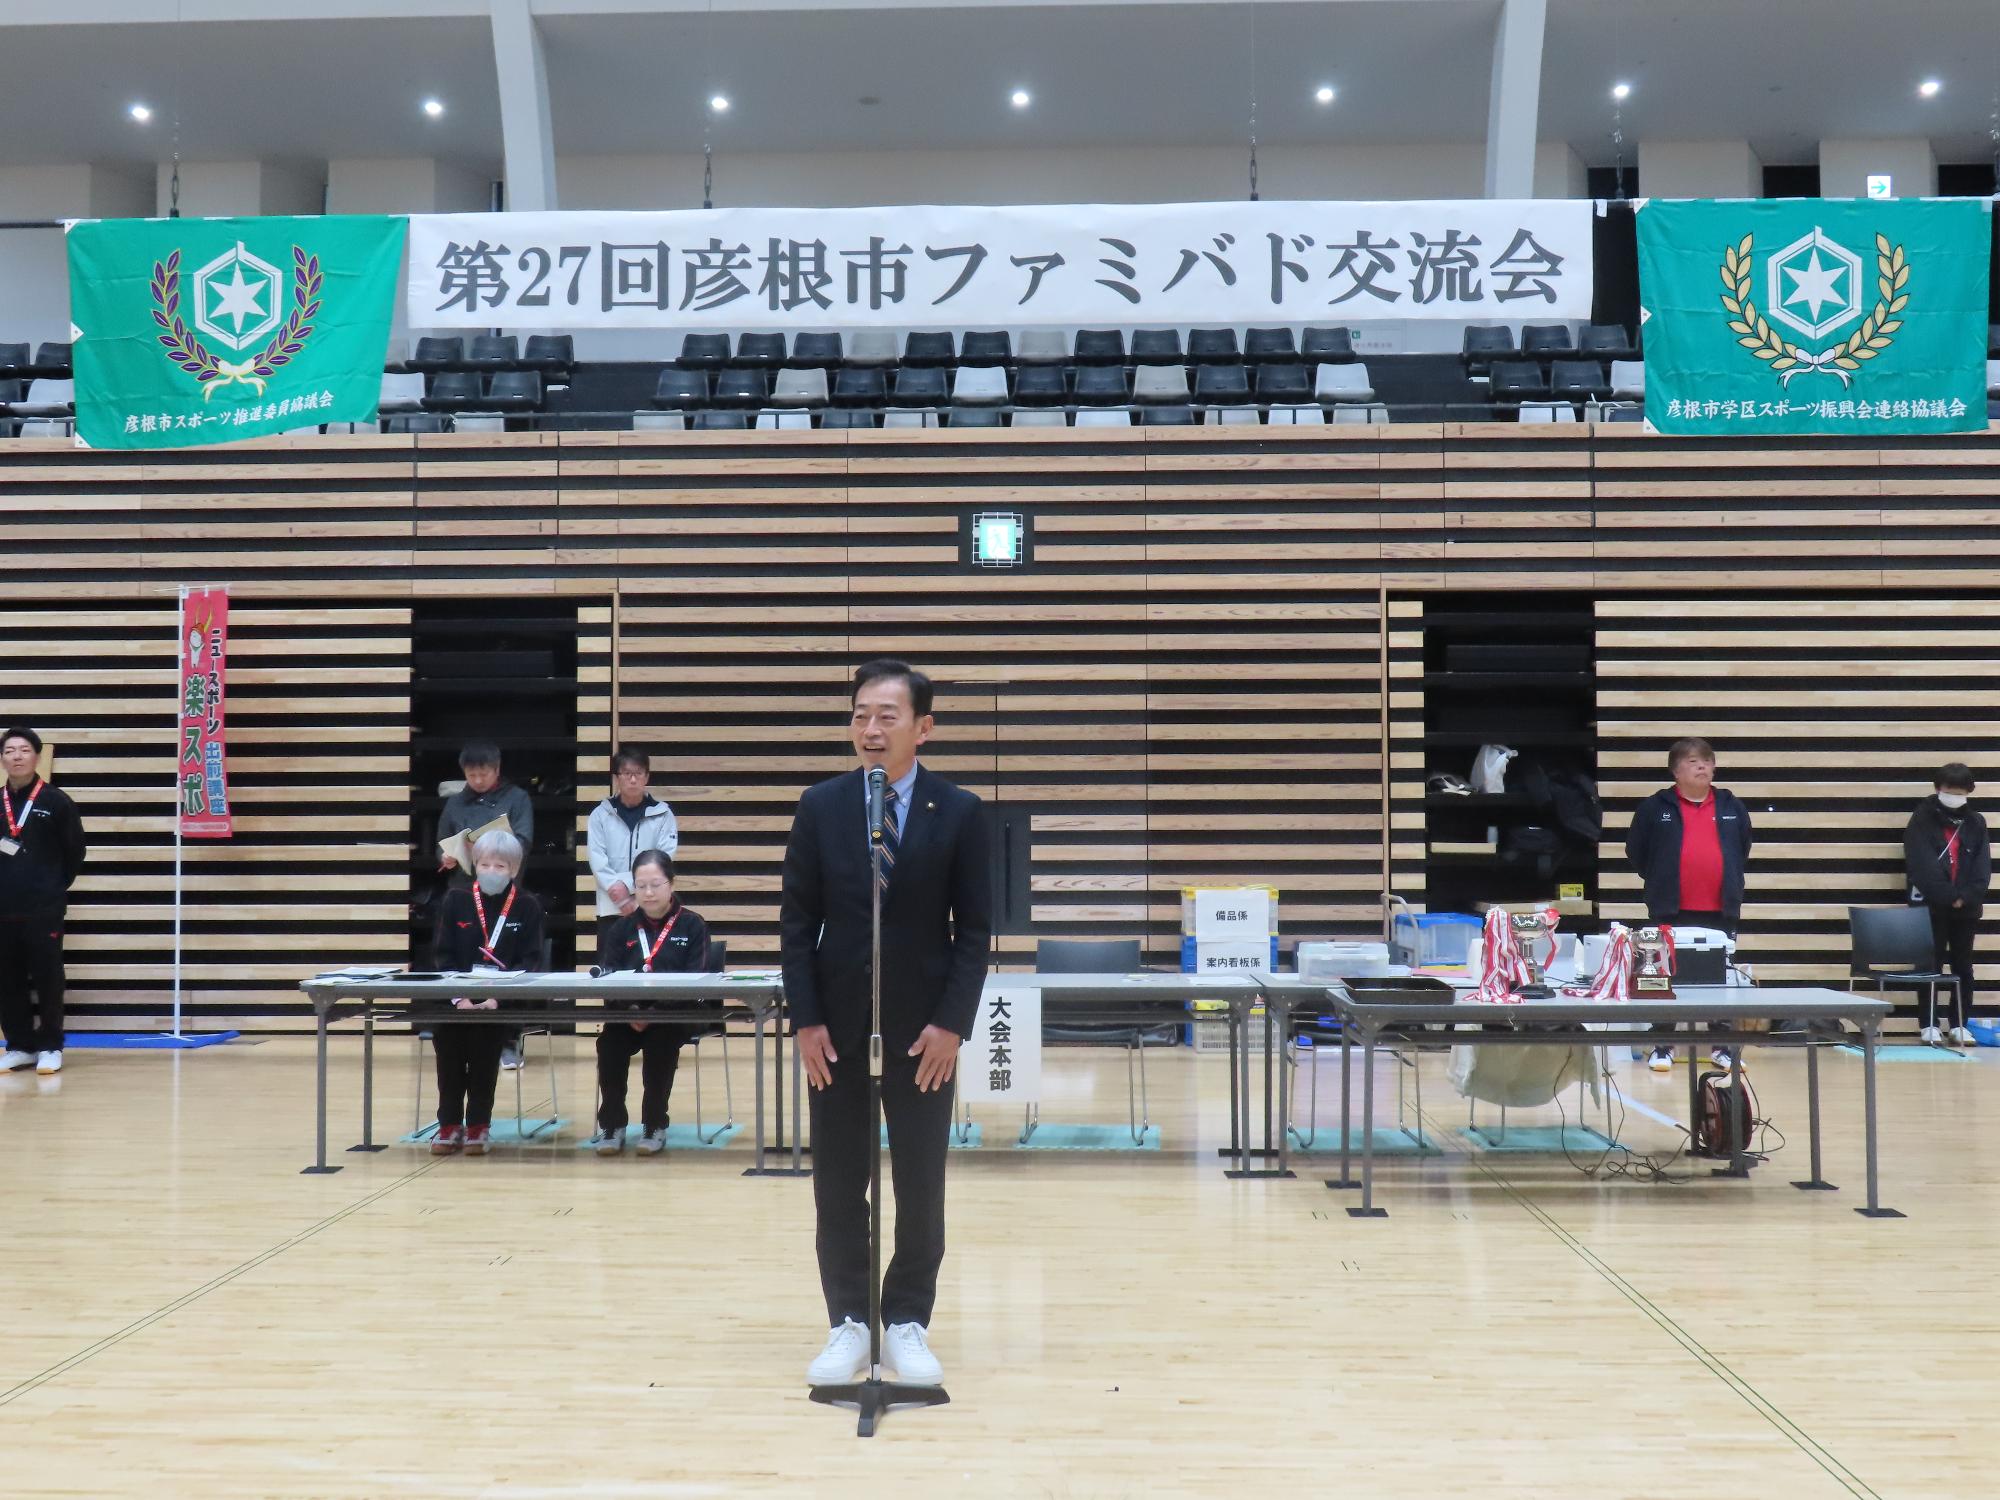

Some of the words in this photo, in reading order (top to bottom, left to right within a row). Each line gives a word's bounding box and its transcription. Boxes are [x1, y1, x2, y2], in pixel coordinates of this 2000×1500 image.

[435, 227, 1565, 313] 第27回彦根市ファミバド交流会
[124, 390, 334, 433] 彦根市スポーツ推進委員協議会
[1666, 397, 1968, 421] 彦根市学区スポーツ振興会連絡協議会
[184, 674, 205, 815] 楽スポ
[1215, 910, 1249, 921] 備品係
[1206, 957, 1261, 968] 案内看板係
[989, 996, 1012, 1092] 大会本部
